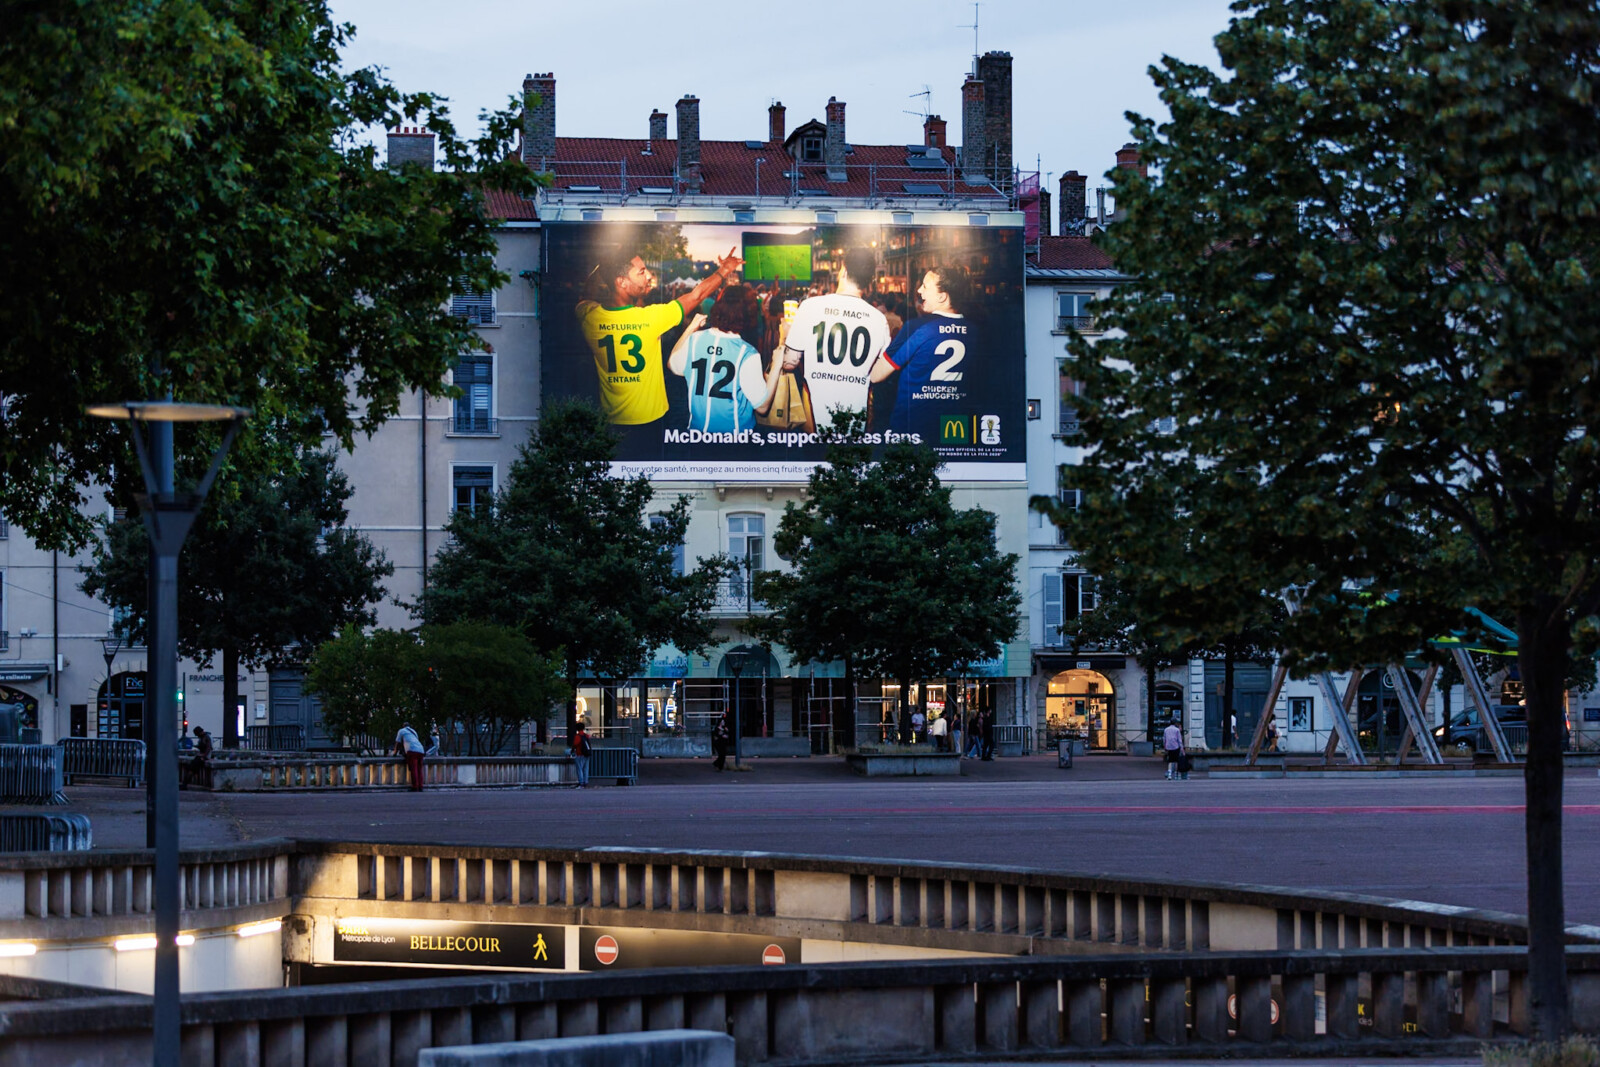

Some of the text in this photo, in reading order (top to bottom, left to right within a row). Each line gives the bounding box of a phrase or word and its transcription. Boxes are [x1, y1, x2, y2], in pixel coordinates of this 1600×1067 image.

[824, 307, 840, 316] BIG
[938, 323, 967, 334] BOÎTE
[812, 321, 871, 367] 100
[597, 333, 646, 374] 13
[706, 345, 723, 356] CB
[930, 339, 966, 382] 2
[608, 375, 641, 384] ENTAMÉ
[691, 357, 735, 400] 12
[811, 371, 867, 386] CORNICHONS
[921, 385, 958, 393] CHICKEN
[621, 465, 640, 473] Pour
[664, 464, 689, 474] santé,
[690, 466, 722, 475] mangez
[735, 465, 761, 473] moins
[762, 465, 780, 475] cinq
[781, 465, 803, 473] fruits
[341, 933, 396, 944] Métropole de Lyon
[410, 935, 501, 952] BELLECOUR
